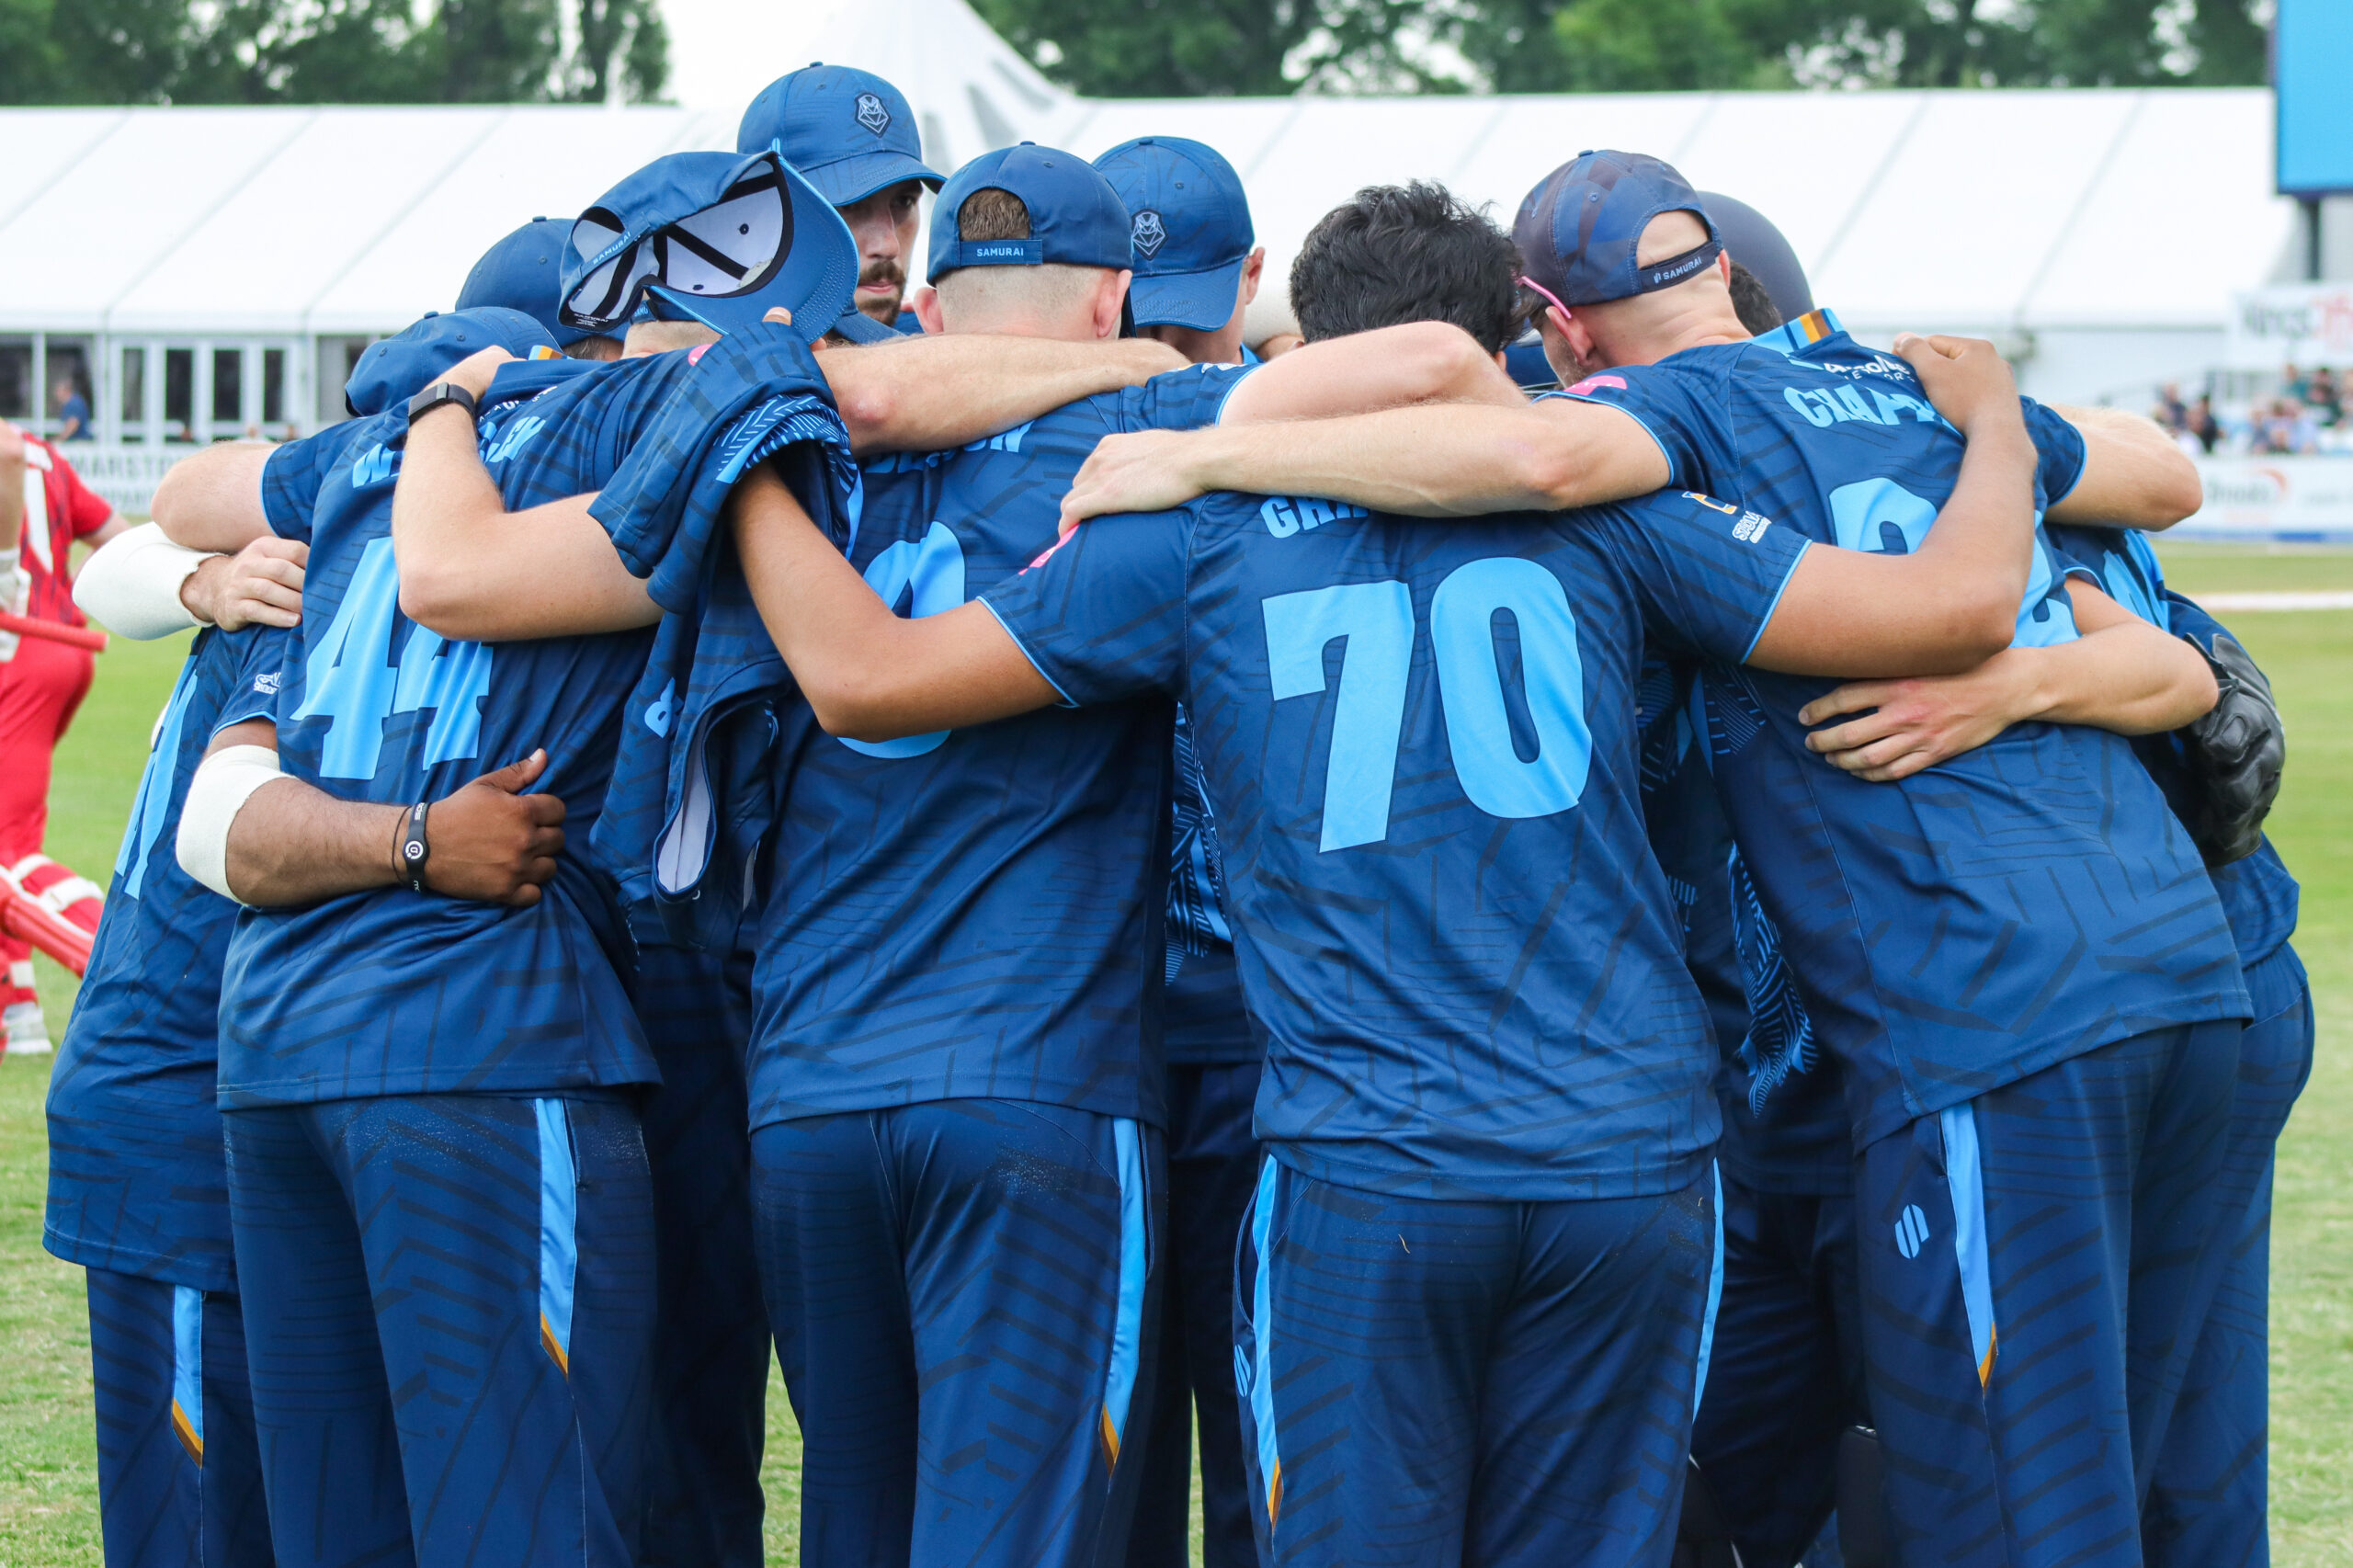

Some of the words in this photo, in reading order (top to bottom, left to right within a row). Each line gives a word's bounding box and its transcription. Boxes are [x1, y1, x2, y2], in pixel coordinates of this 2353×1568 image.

[976, 247, 1024, 257] SAMURAI
[1663, 256, 1702, 280] SAMURAI
[290, 537, 494, 780] 44
[1262, 557, 1593, 854] 70
